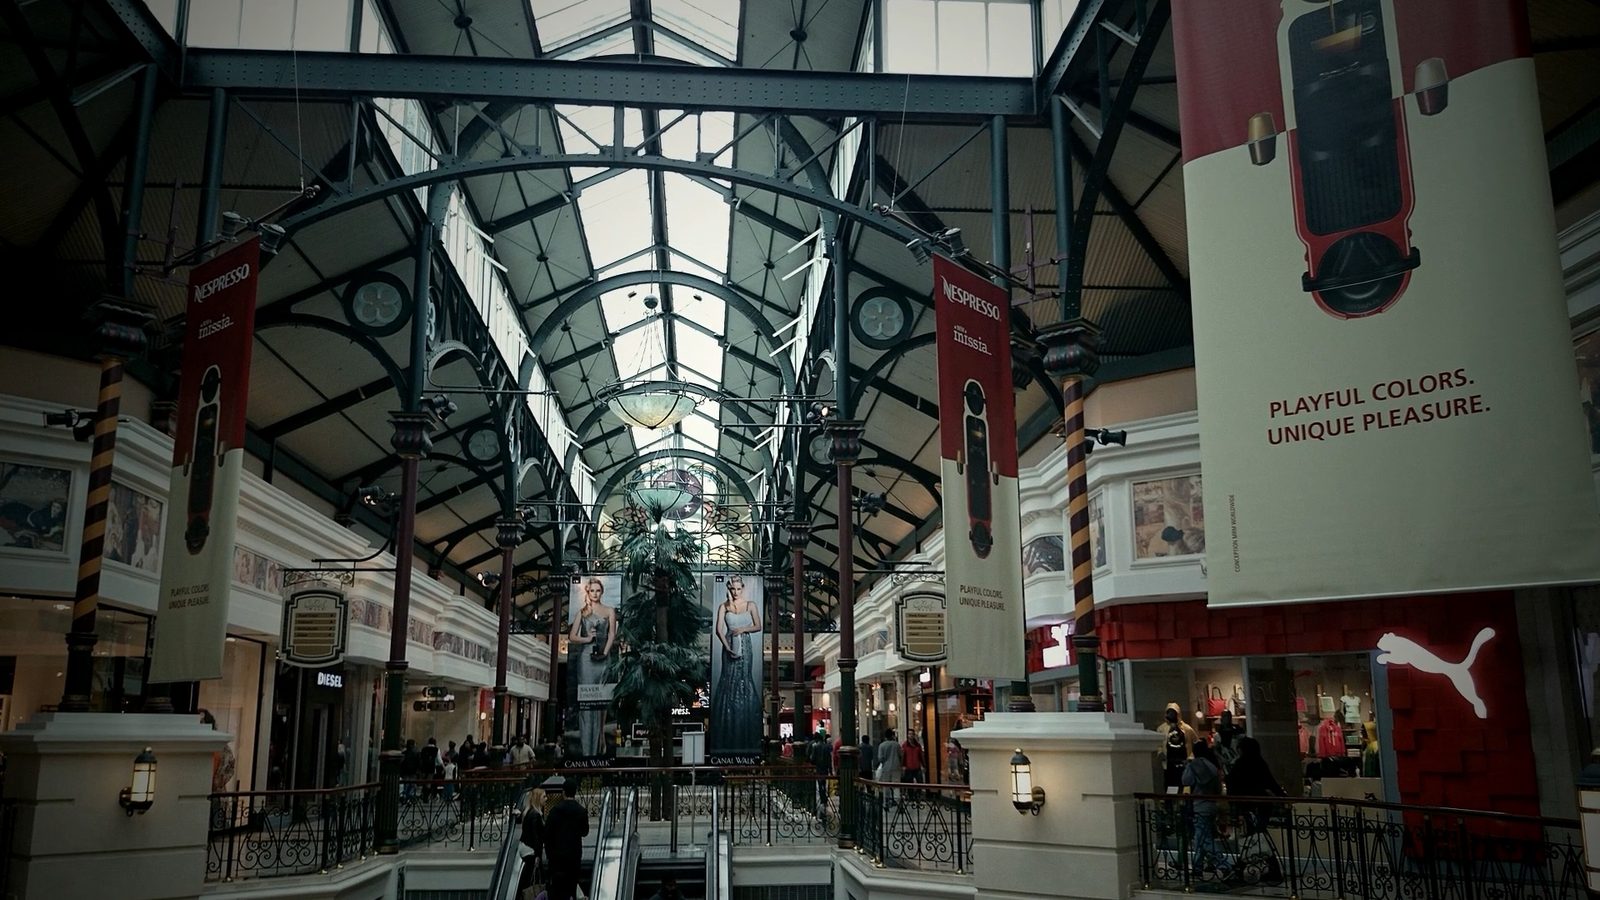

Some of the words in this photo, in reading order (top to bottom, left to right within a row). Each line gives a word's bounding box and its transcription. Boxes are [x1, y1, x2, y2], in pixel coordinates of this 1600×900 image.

[1269, 389, 1365, 418] PLAYFUL
[1371, 368, 1475, 401] COLORS.
[1268, 416, 1355, 445] UNIQUE
[1362, 394, 1491, 431] PLEASURE.
[317, 671, 343, 688] DIESEL
[564, 760, 588, 768] CANAL
[590, 759, 611, 767] WALK
[710, 756, 734, 765] CANAL
[735, 756, 755, 765] WALK
